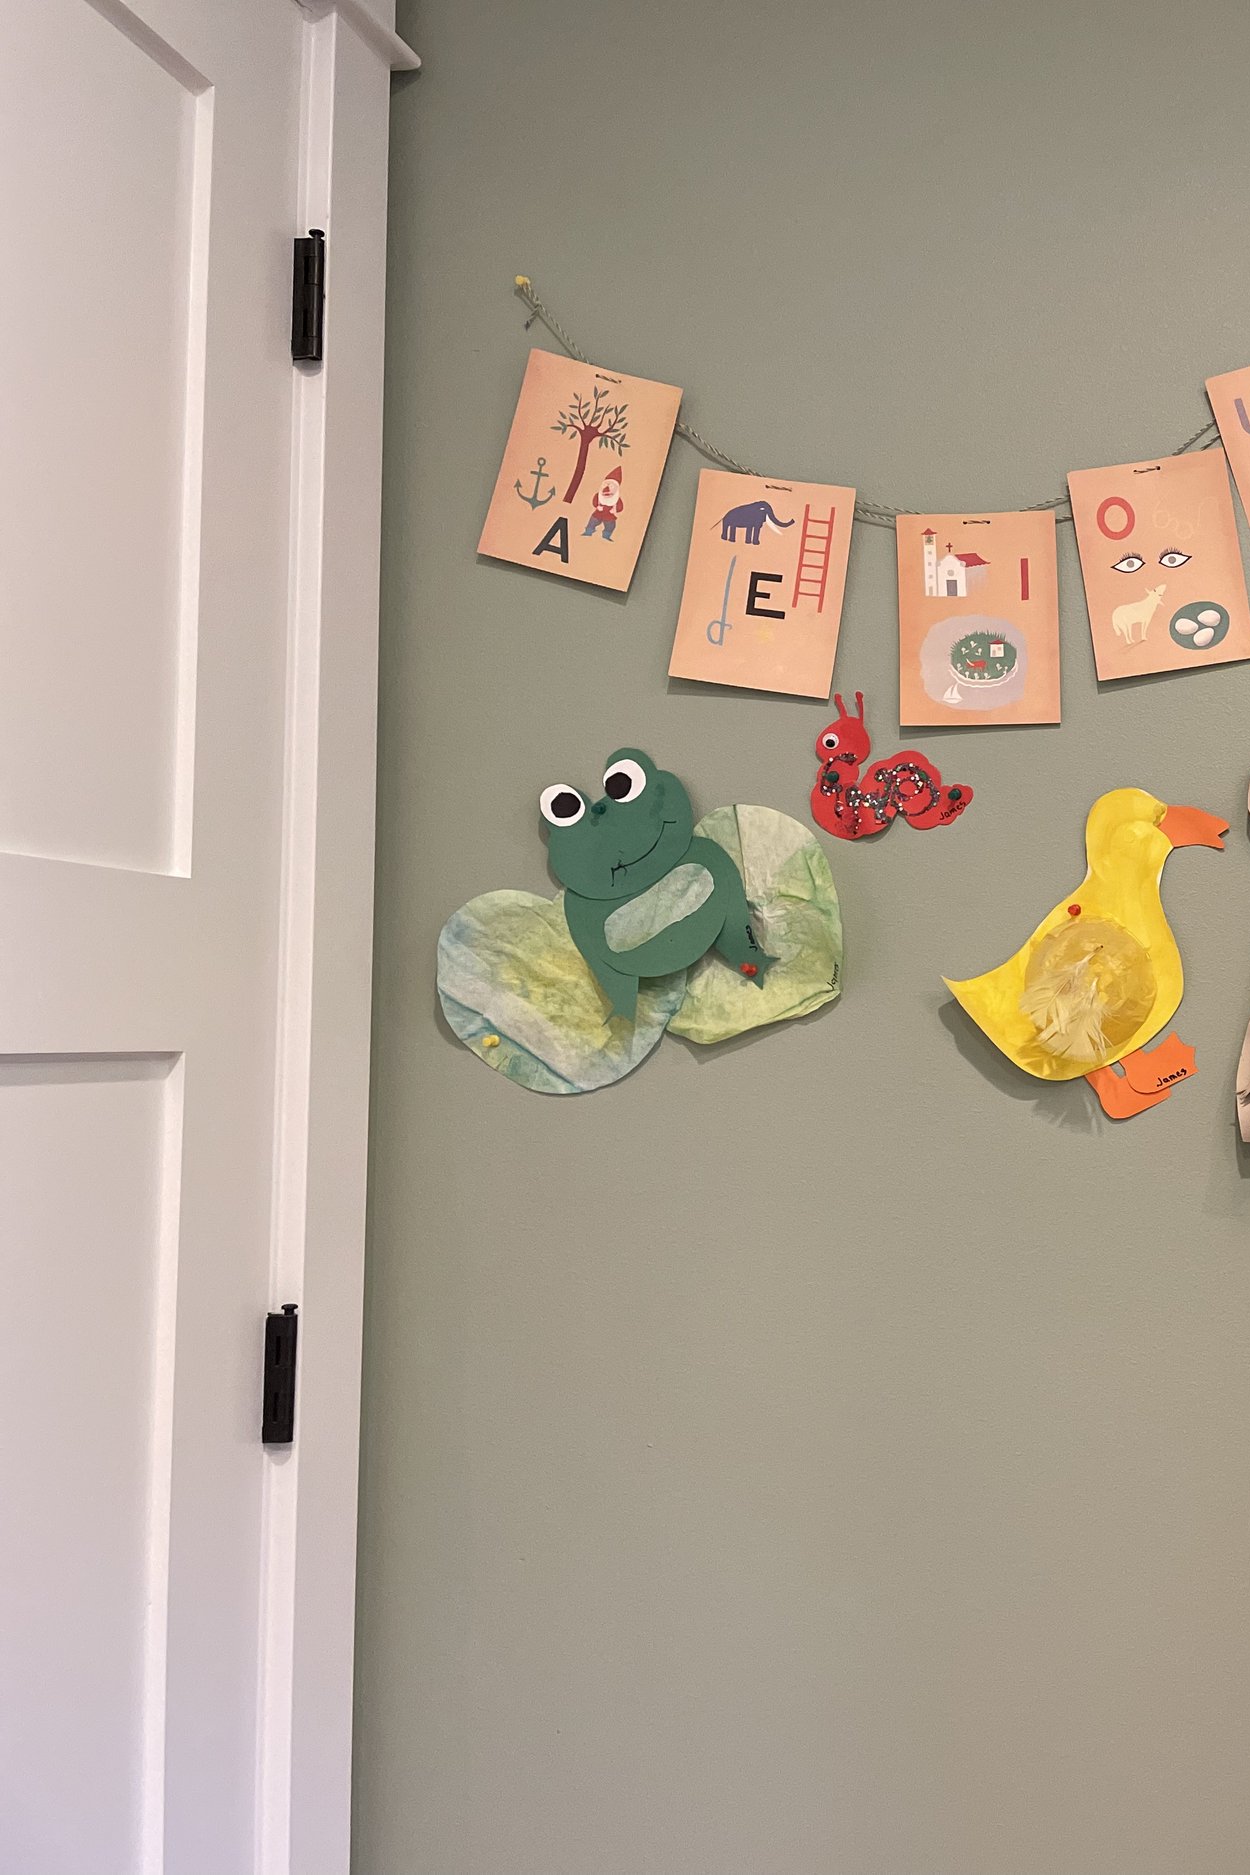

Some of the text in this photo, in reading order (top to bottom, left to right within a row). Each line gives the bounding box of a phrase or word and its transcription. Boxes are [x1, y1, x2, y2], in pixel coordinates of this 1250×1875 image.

[532, 516, 569, 563] A
[1097, 496, 1135, 540] O
[745, 571, 785, 619] E
[1020, 558, 1029, 600] I
[939, 801, 967, 820] James
[1156, 1067, 1187, 1088] James
